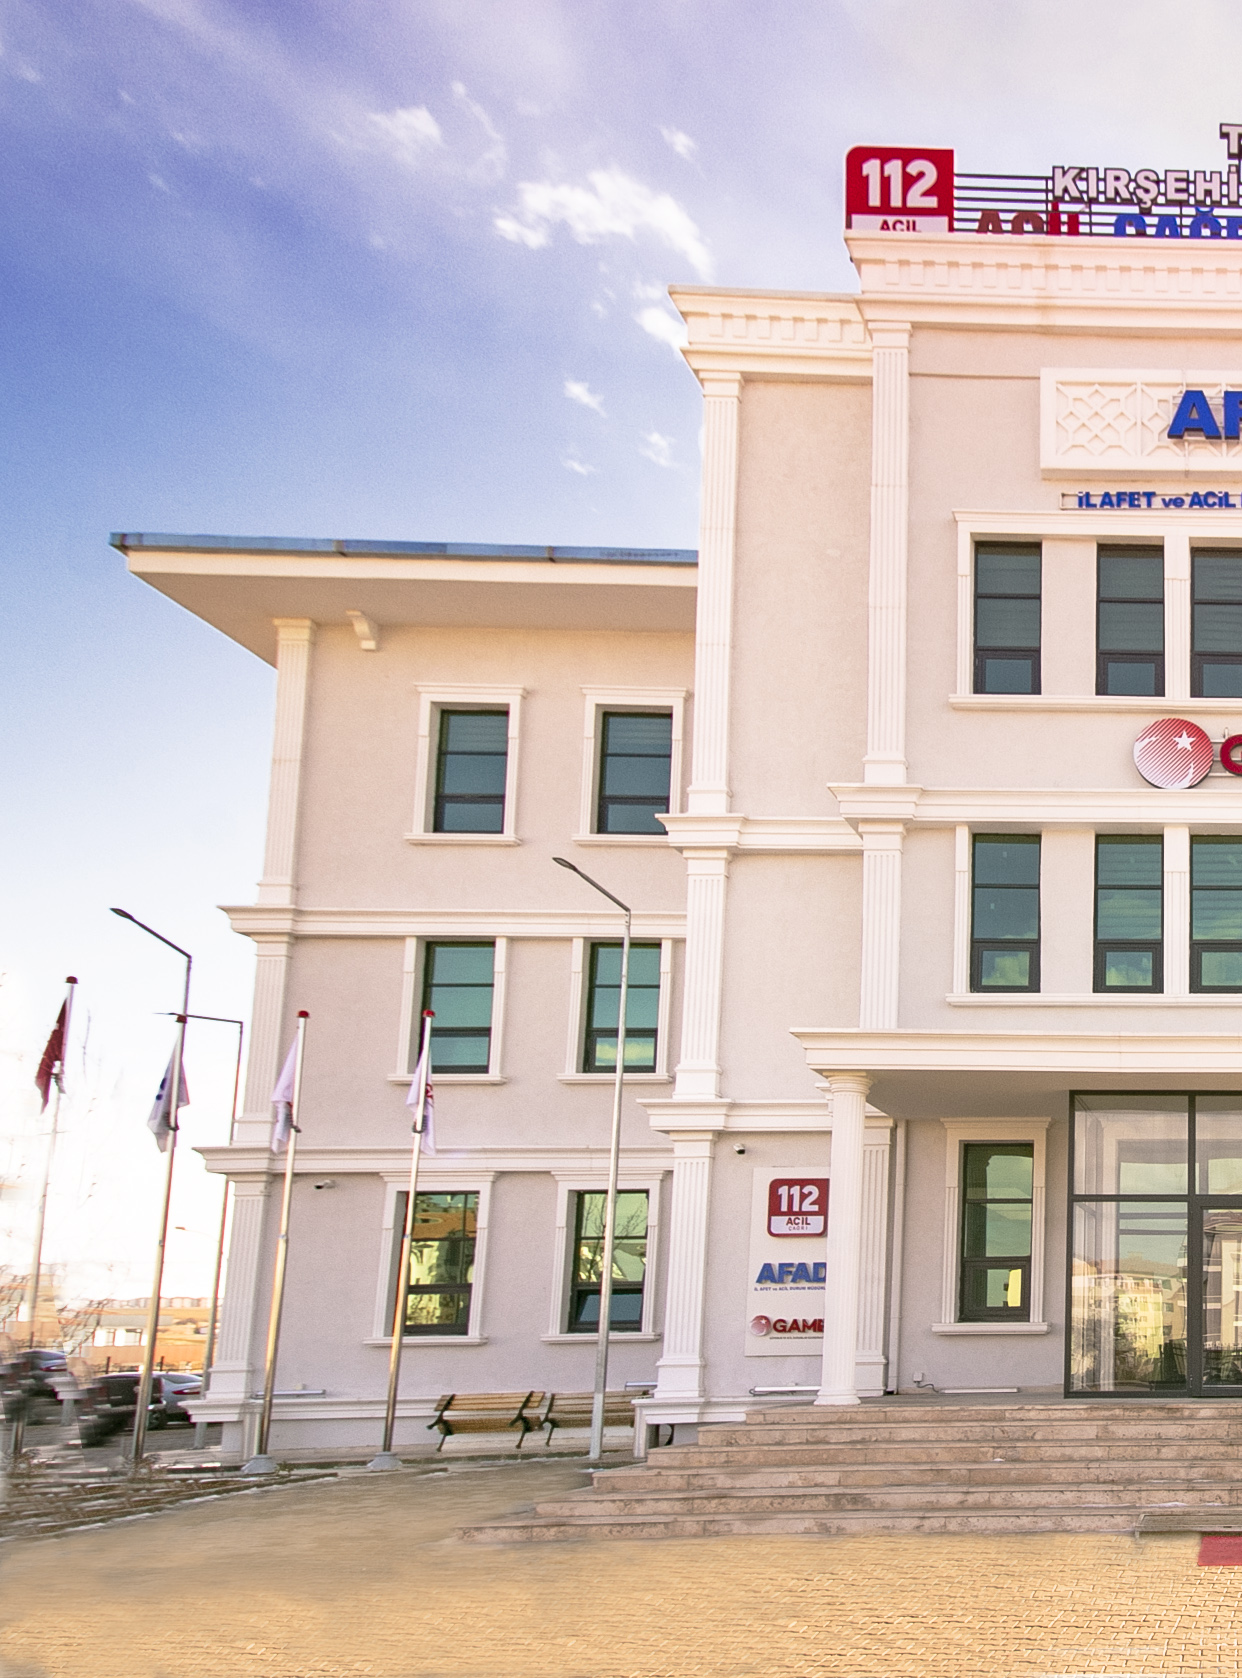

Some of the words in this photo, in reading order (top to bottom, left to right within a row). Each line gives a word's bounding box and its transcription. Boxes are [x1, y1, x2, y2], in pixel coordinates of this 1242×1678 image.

[861, 157, 938, 208] 112
[1160, 497, 1186, 509] ve
[777, 1184, 820, 1212] 112
[756, 1262, 827, 1284] AFAD
